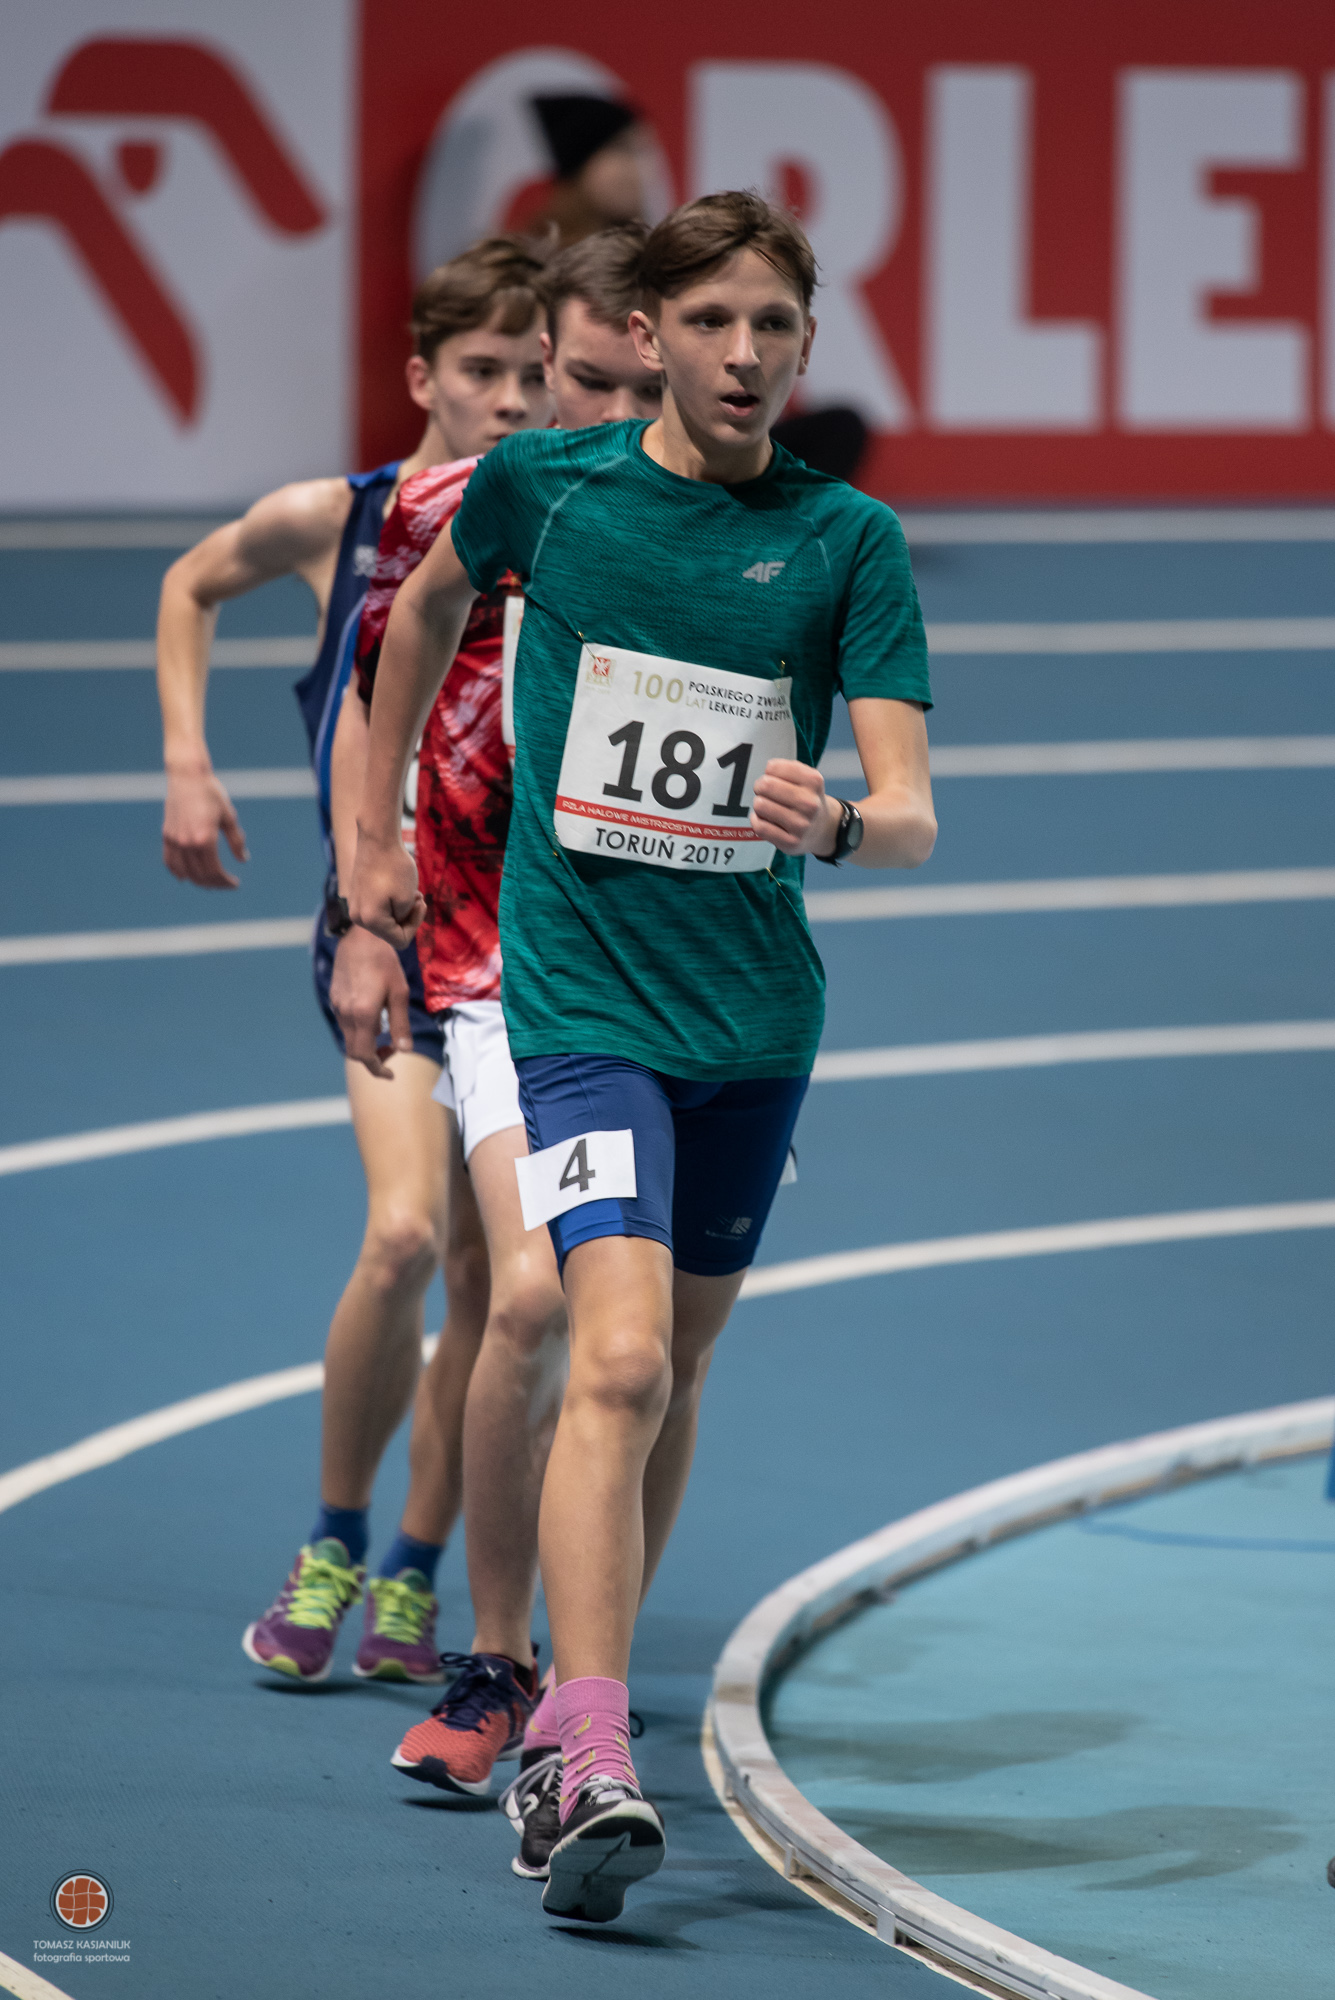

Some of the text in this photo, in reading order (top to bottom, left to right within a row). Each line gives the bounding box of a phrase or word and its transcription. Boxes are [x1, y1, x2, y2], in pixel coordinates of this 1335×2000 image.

[412, 45, 1335, 433] ORLE
[742, 561, 786, 583] 4F
[633, 671, 684, 703] 100
[688, 681, 754, 704] POLSKIEGO
[685, 696, 705, 710] LAT
[708, 701, 752, 718] LEKKIEJ
[602, 720, 754, 818] 181
[587, 806, 629, 821] HALOWE
[630, 815, 702, 834] MISTRZOSTWA
[703, 827, 737, 838] POLSKI
[595, 827, 735, 866] TORUŃ 2019
[559, 1138, 596, 1192] 4
